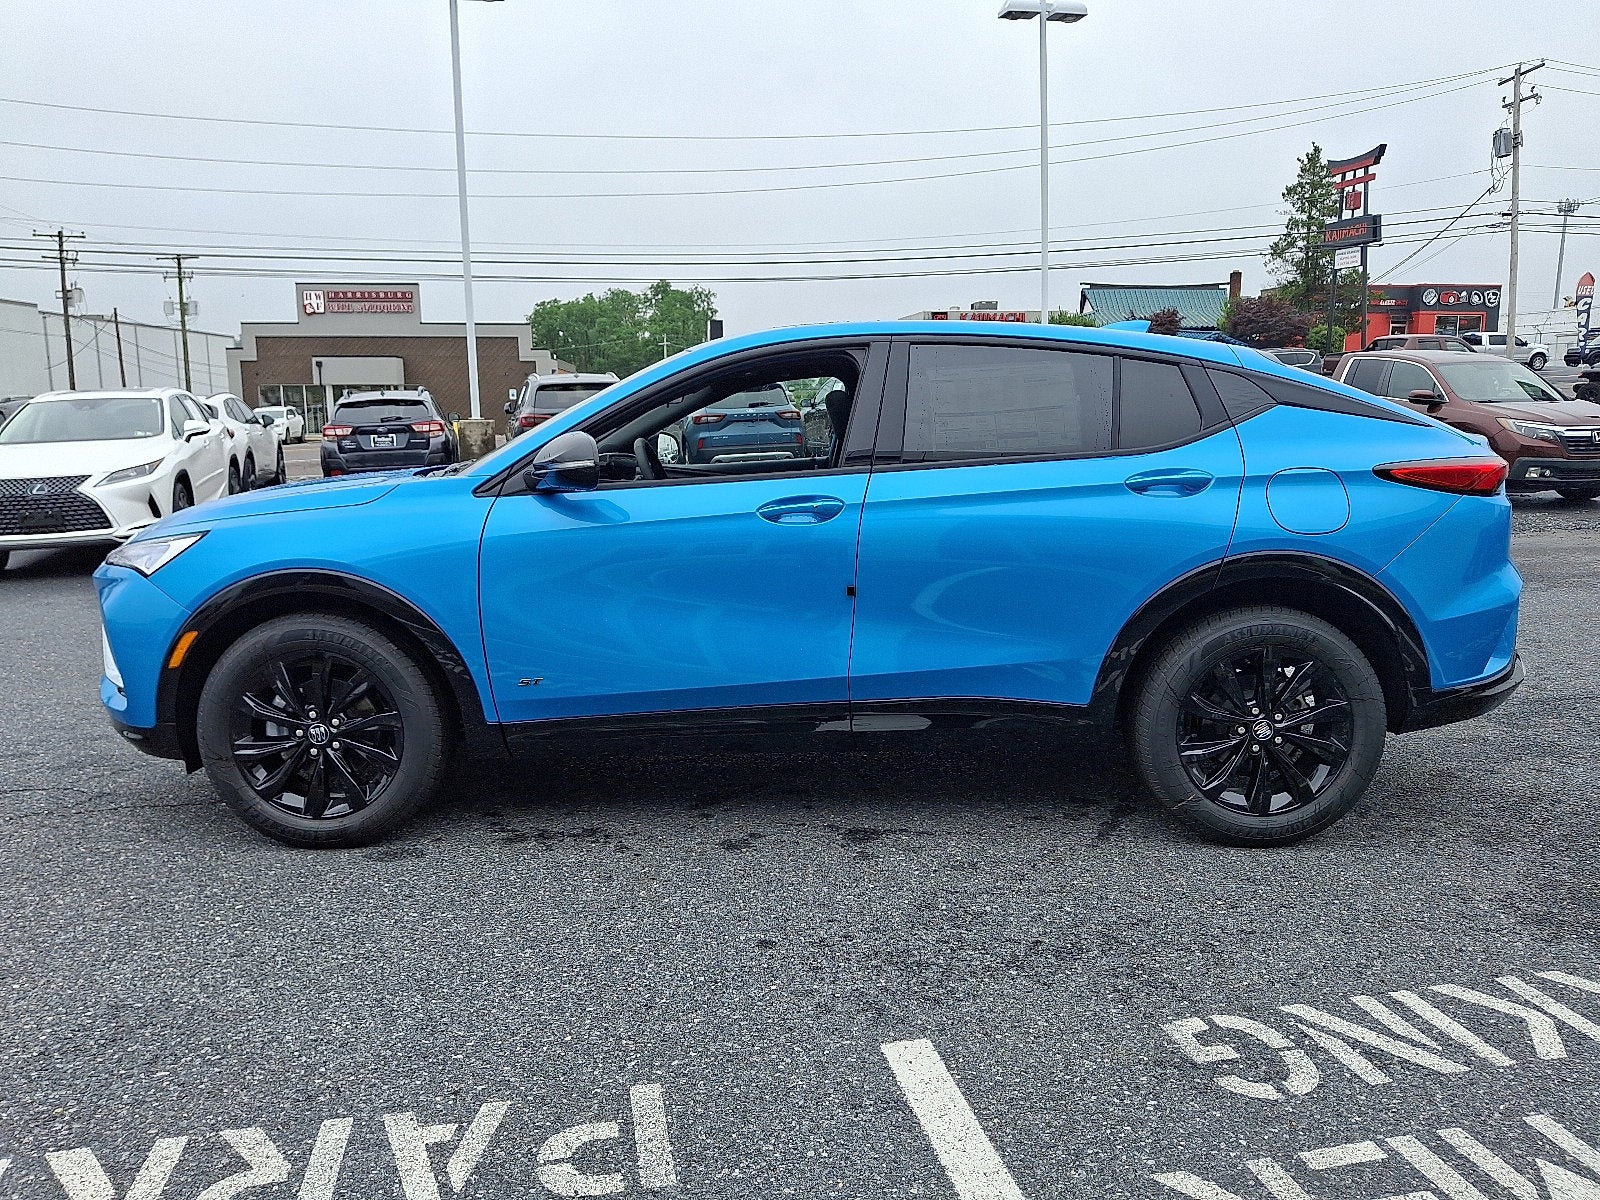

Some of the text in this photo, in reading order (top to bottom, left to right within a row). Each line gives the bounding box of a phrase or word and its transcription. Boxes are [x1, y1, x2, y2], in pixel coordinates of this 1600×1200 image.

[1325, 223, 1367, 242] KAJIMACHI
[328, 291, 412, 299] HARRISBURG
[517, 677, 544, 686] ST
[1162, 970, 1600, 1100] KING
[0, 1083, 678, 1200] PARK
